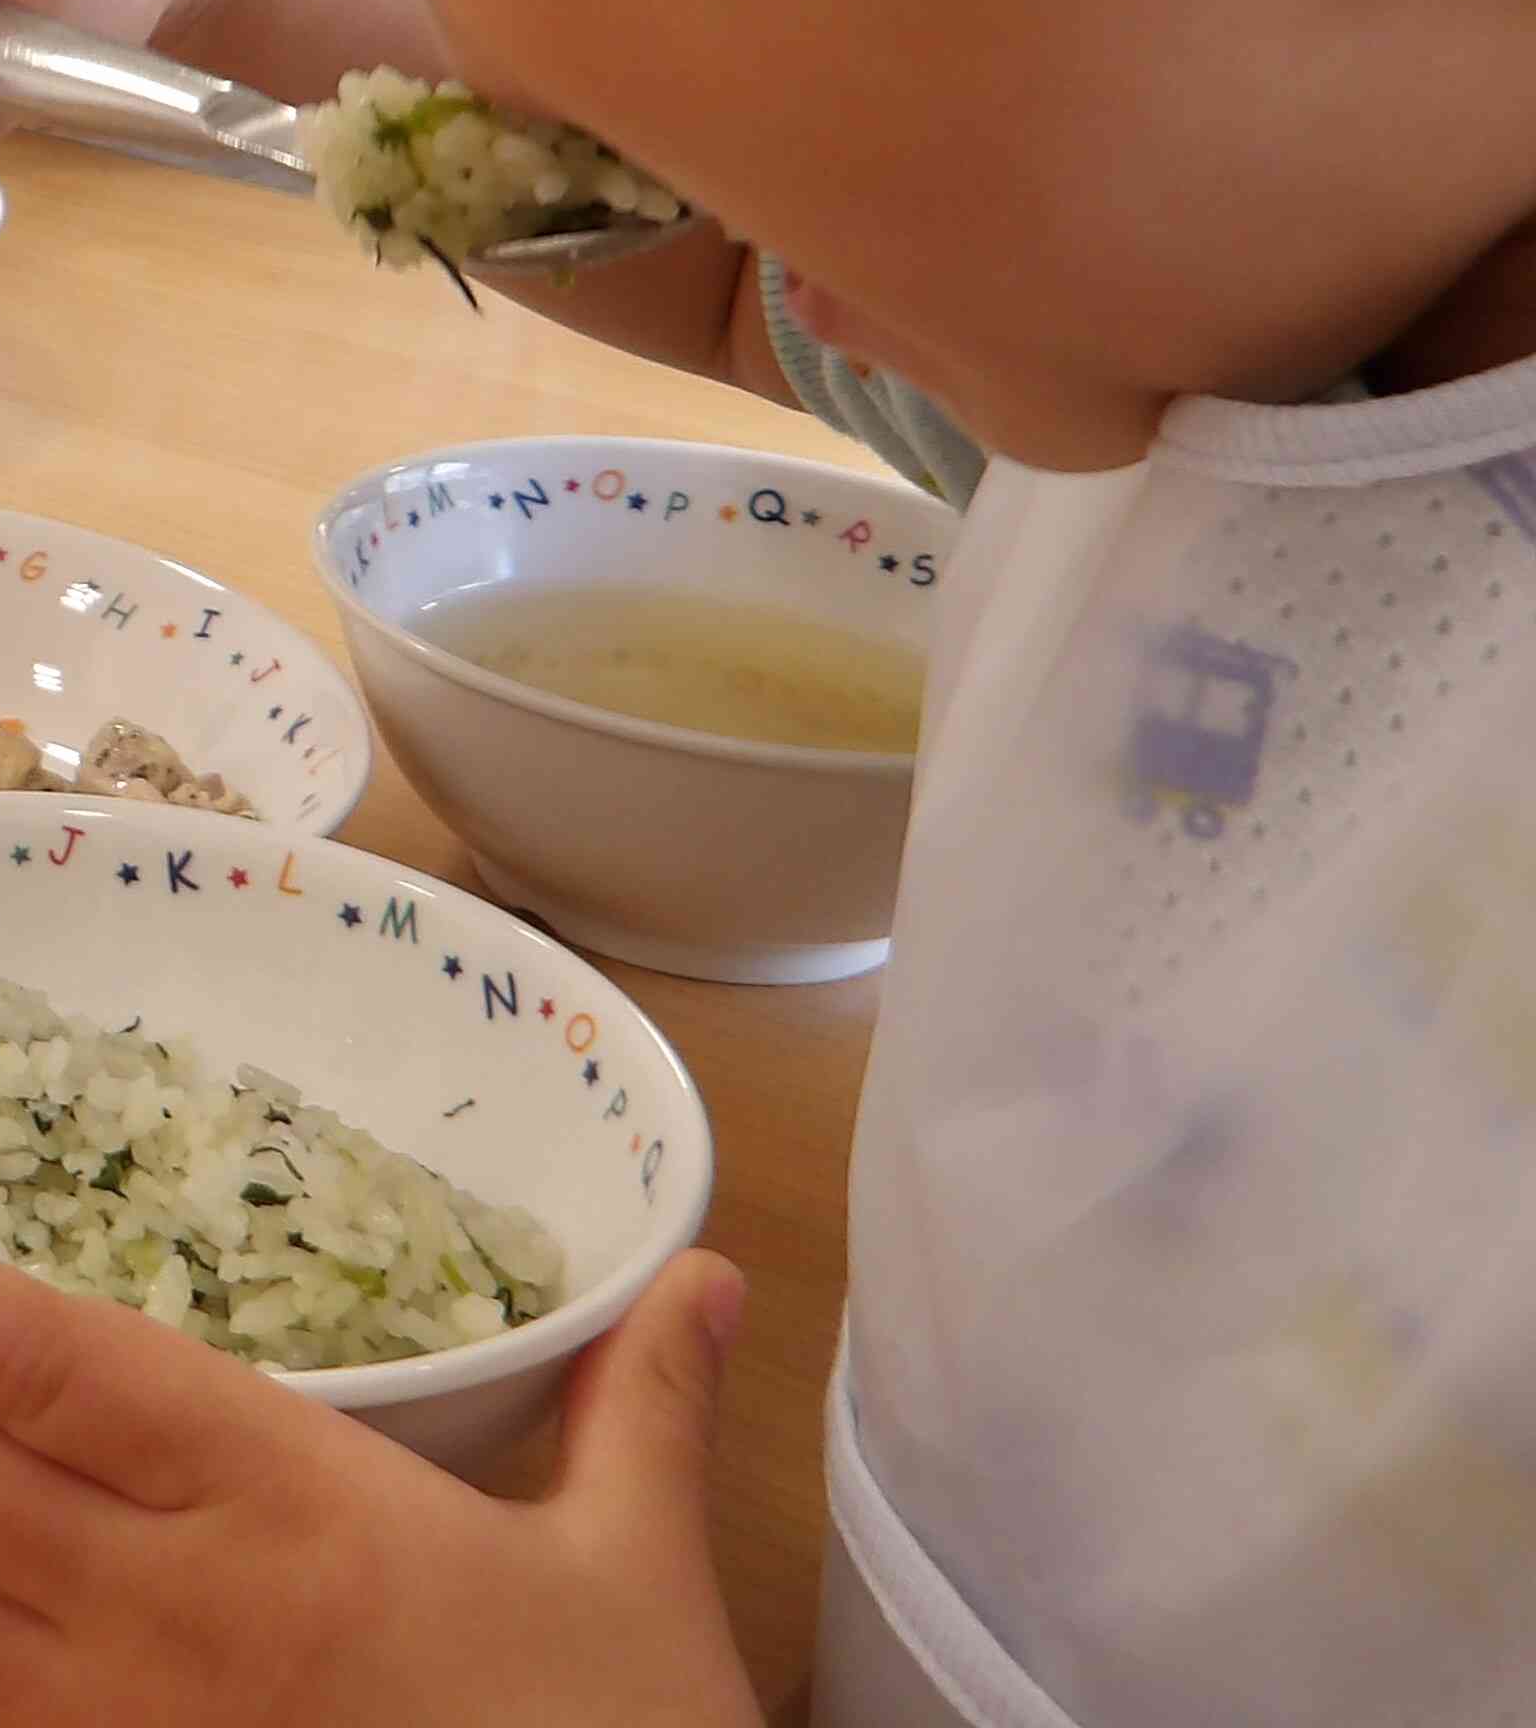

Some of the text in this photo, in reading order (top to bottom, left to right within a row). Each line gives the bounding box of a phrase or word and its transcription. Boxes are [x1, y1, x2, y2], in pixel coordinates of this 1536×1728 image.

[427, 481, 455, 518] M
[512, 477, 551, 521] N
[591, 469, 626, 502] O
[663, 490, 690, 522] P
[748, 487, 792, 527] Q
[838, 519, 872, 554] R
[909, 552, 936, 587] S
[18, 549, 50, 583] G
[100, 591, 140, 631] H
[192, 607, 222, 639] I
[249, 657, 283, 683] J
[280, 712, 313, 745] K
[47, 825, 87, 866] J
[165, 849, 201, 894] K
[277, 848, 304, 896] L
[378, 895, 419, 945] M
[482, 970, 520, 1021] N
[564, 1011, 598, 1055] O
[601, 1087, 628, 1121] P
